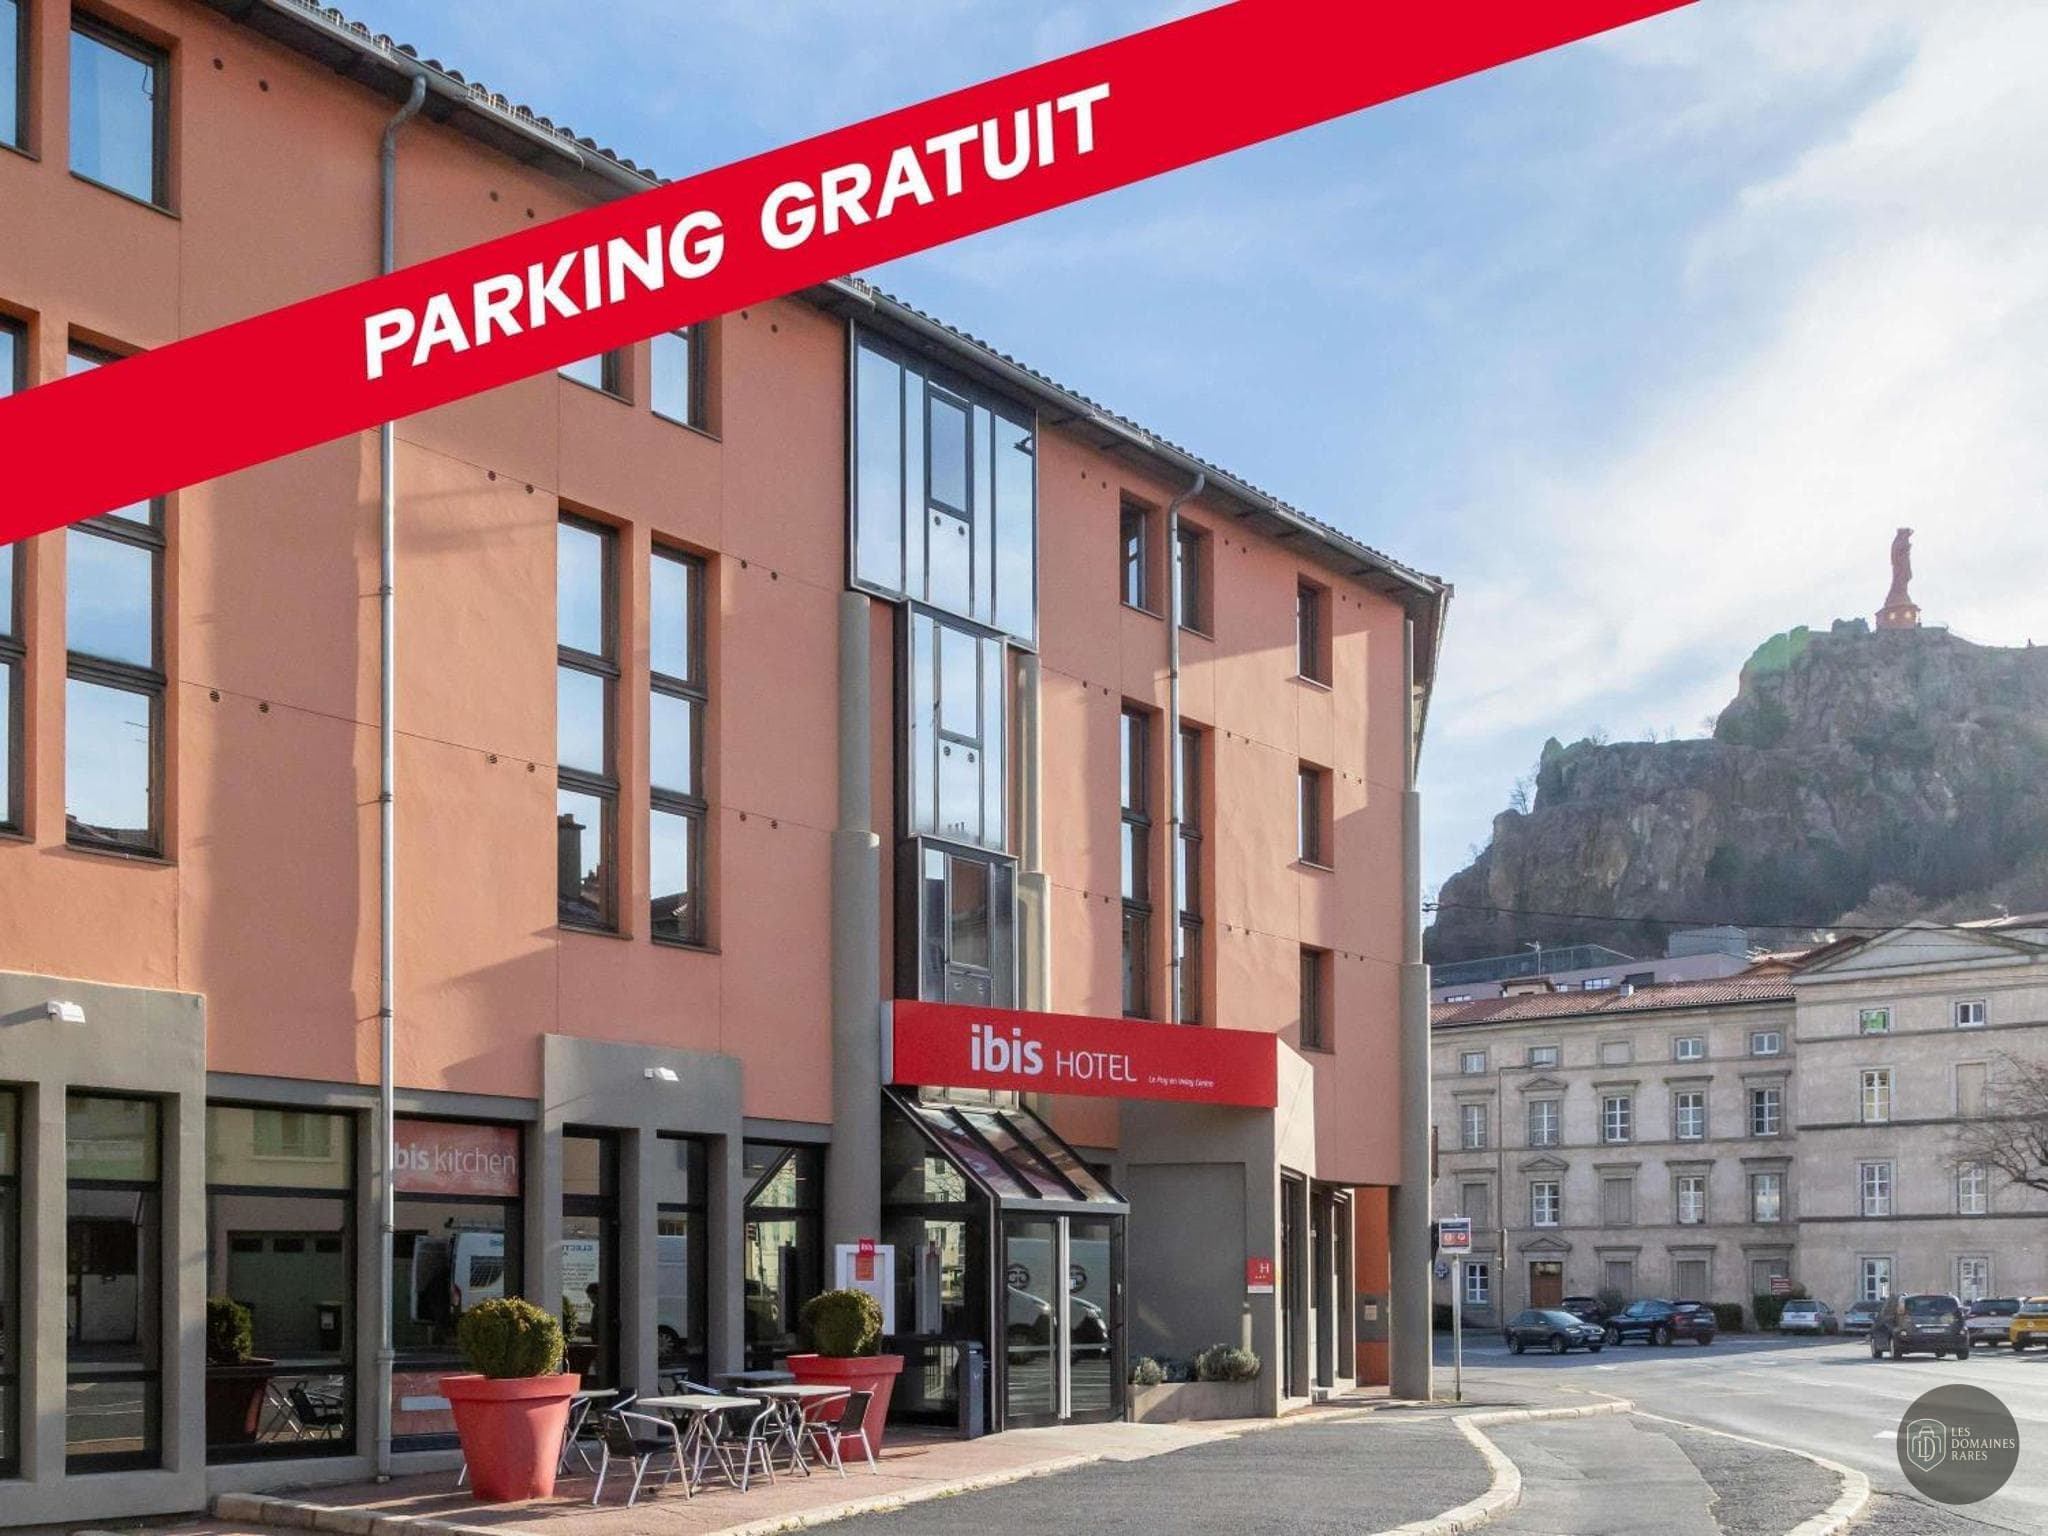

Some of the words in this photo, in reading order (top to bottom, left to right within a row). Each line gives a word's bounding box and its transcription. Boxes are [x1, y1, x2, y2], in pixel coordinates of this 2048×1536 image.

[971, 1023, 1044, 1075] ibis
[1056, 1050, 1137, 1082] HOTEL
[394, 1142, 430, 1171] bis
[434, 1144, 516, 1177] kitchen
[1260, 1262, 1270, 1274] H
